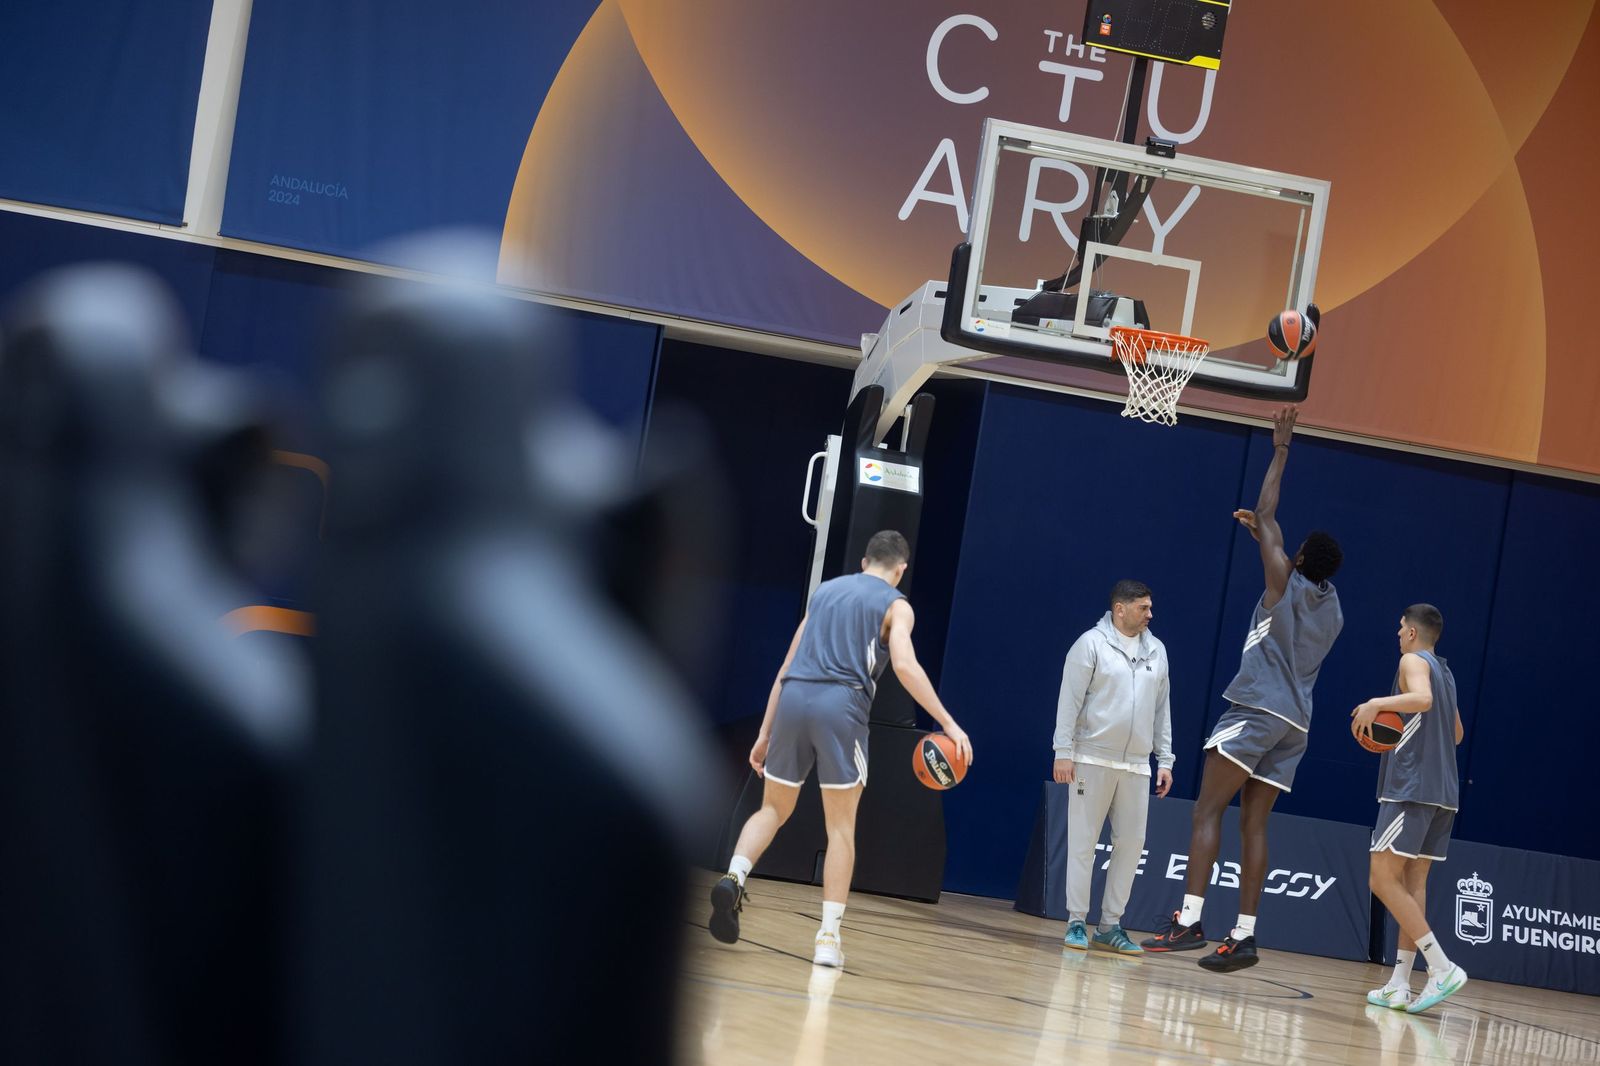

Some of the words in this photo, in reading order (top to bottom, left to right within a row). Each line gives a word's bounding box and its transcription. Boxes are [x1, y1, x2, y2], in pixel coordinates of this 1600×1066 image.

[1043, 29, 1107, 63] THE
[268, 189, 300, 206] 2024
[270, 174, 349, 200] ANDALUCÍA
[924, 749, 952, 786] SPALDING
[1165, 853, 1337, 900] EBSSY
[1502, 903, 1600, 932] AYUNTAMIE
